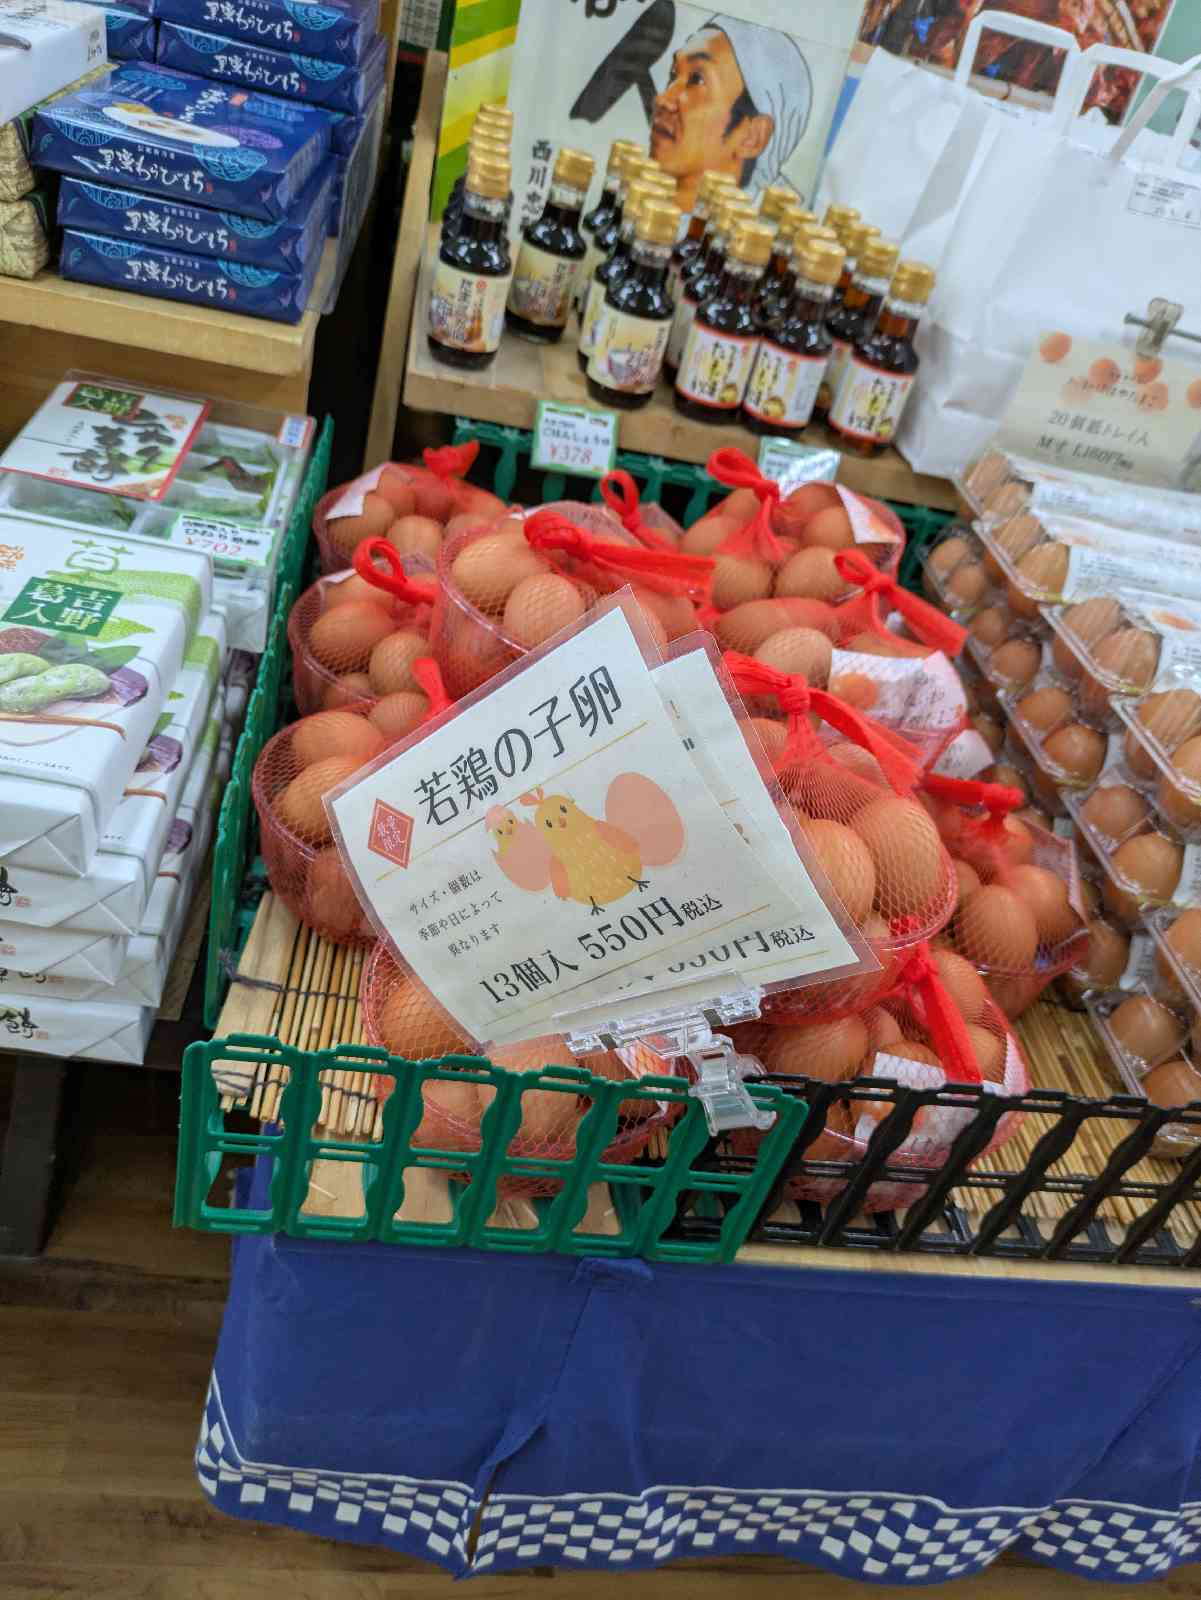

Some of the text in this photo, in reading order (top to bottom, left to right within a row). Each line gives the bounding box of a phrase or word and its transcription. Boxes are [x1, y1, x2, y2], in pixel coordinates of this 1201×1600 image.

[414, 665, 622, 826] 若鶏の子卵
[409, 869, 483, 915] サイズ・個数は
[418, 890, 503, 941] 季節や日によって
[447, 922, 500, 957] 異なります
[480, 949, 579, 1004] 13個入
